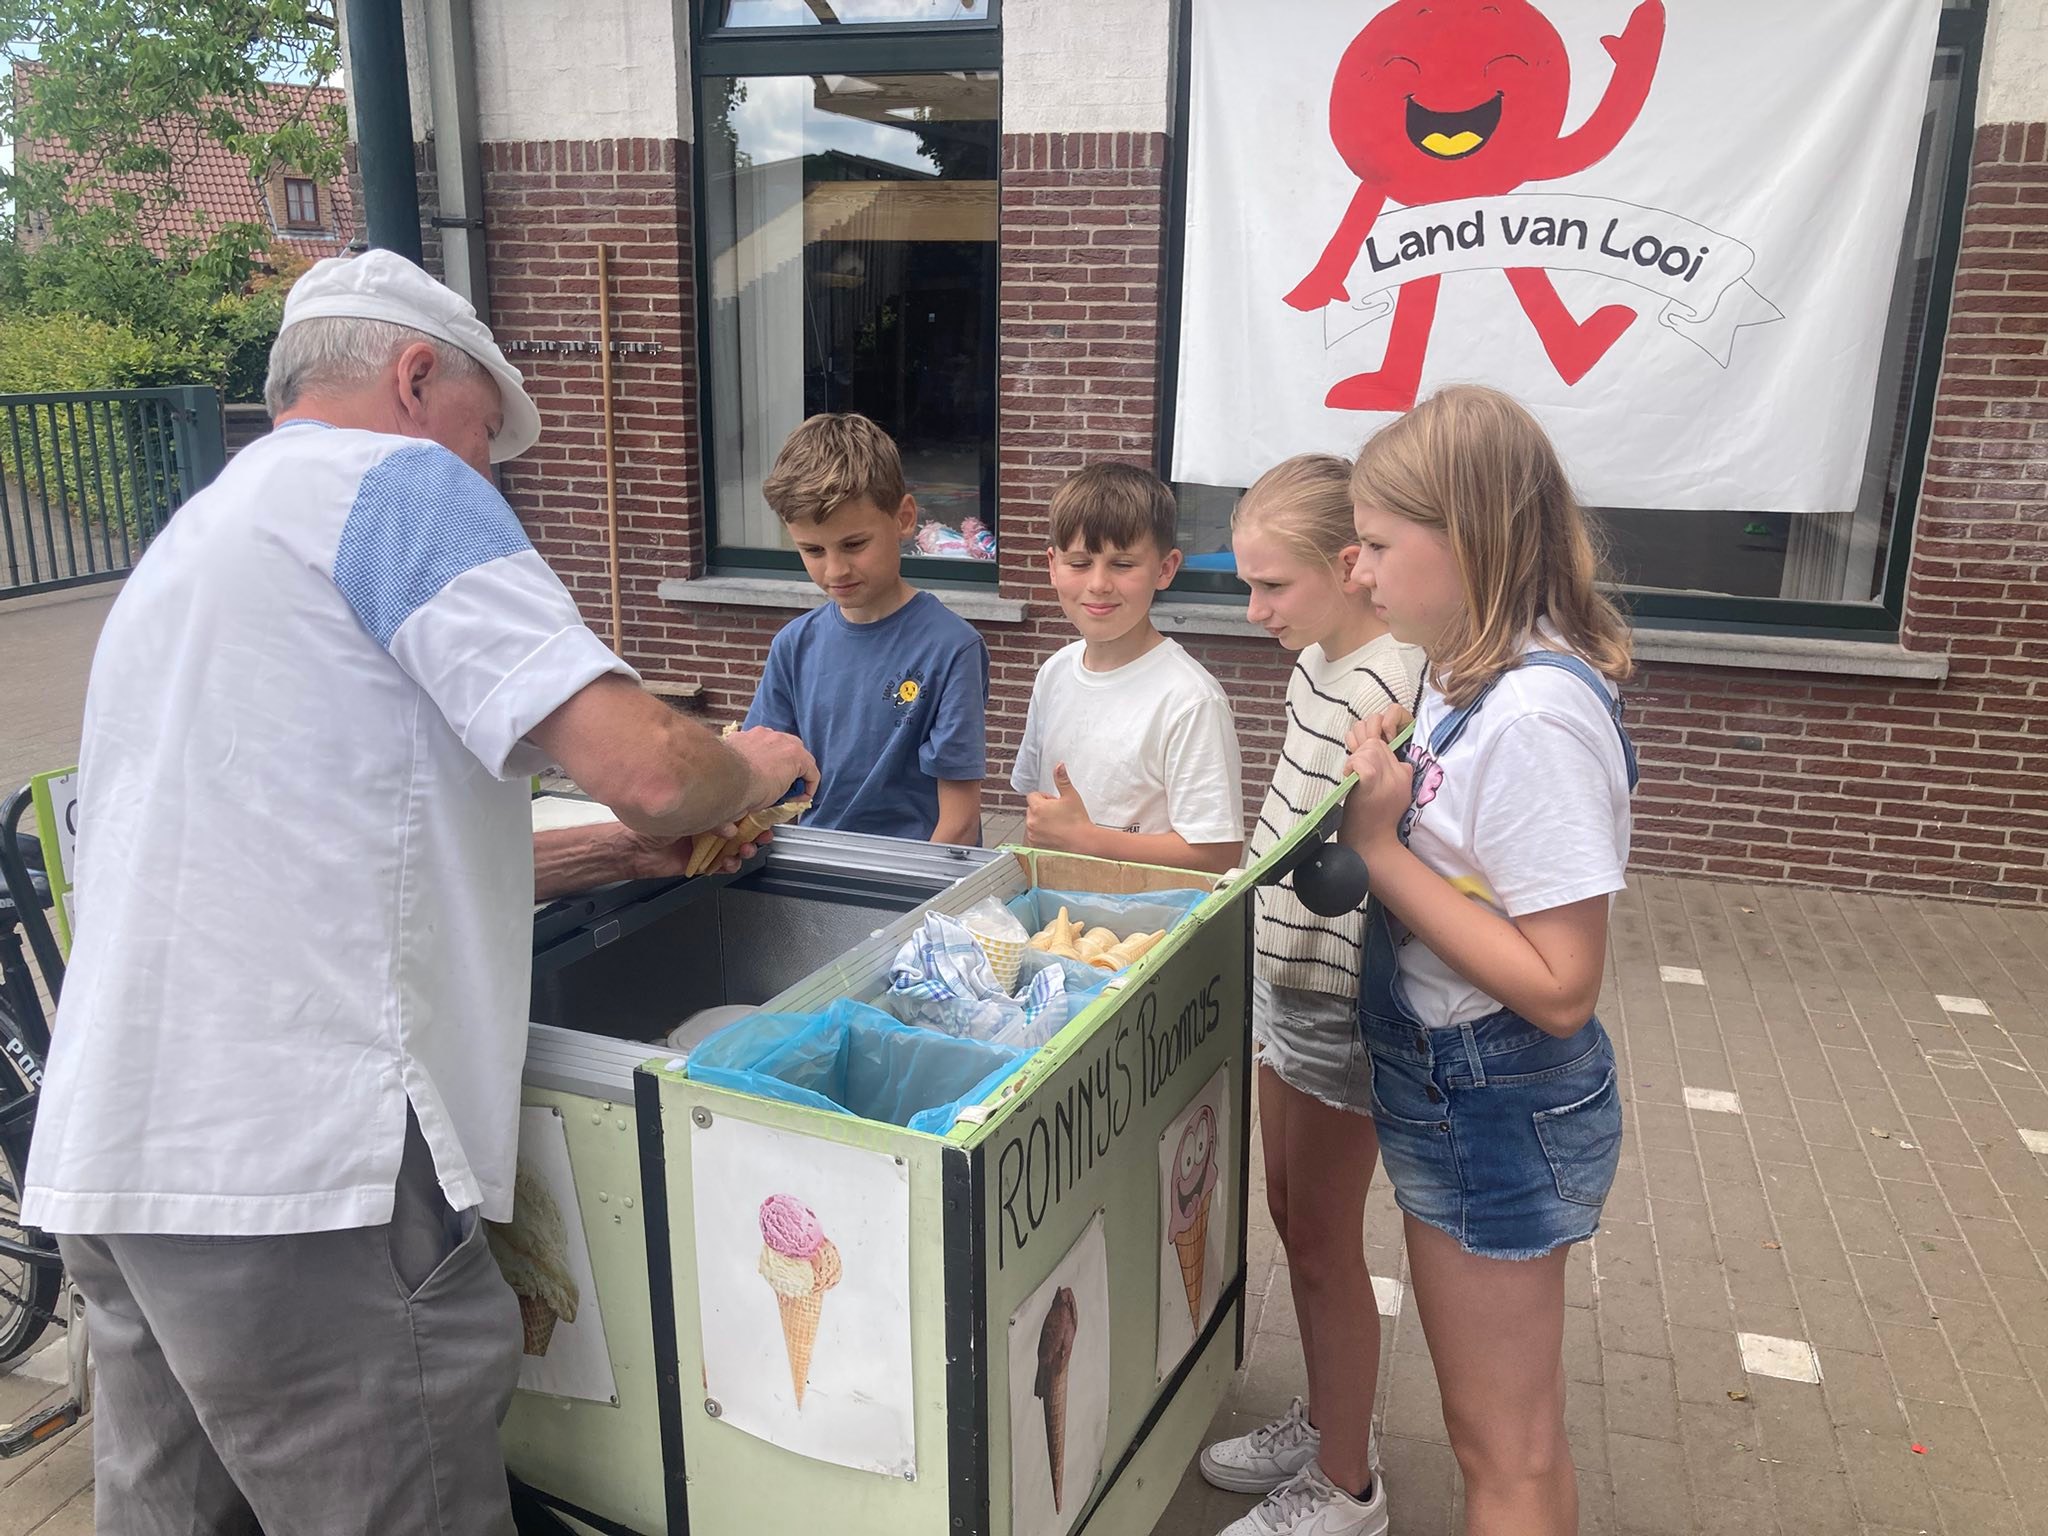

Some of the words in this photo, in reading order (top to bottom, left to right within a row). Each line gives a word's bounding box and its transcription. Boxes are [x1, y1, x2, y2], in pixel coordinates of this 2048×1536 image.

[1366, 210, 1485, 272] Land
[1501, 216, 1588, 249] van
[1600, 218, 1709, 282] Looi
